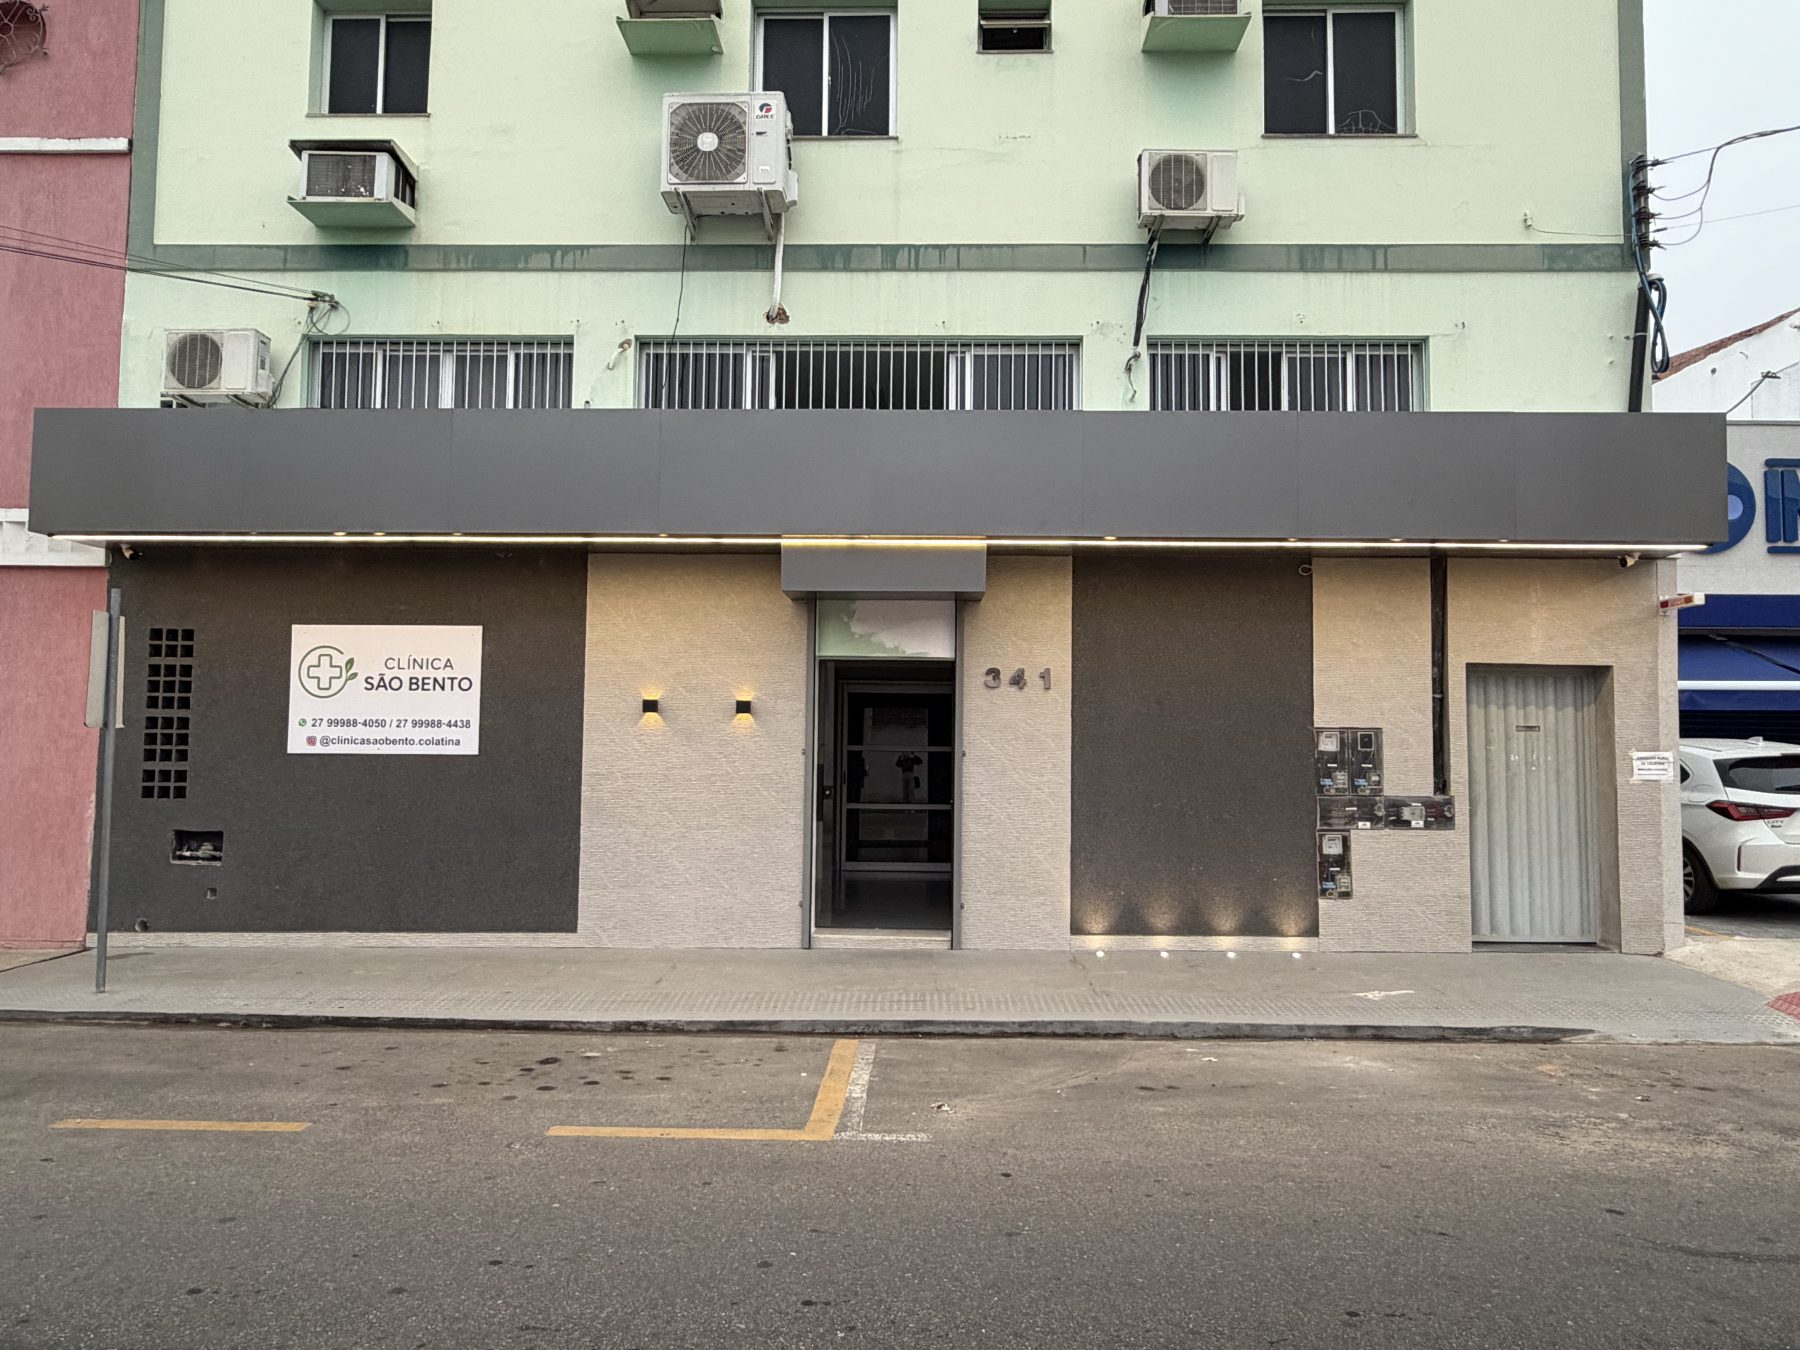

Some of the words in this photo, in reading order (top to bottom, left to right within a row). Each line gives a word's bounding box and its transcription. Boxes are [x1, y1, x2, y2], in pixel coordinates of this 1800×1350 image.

[384, 654, 454, 671] CLÍNICA
[364, 673, 403, 692] SÃO
[408, 676, 473, 692] BENTO
[984, 667, 1051, 690] 341
[311, 718, 324, 728] 27
[327, 718, 387, 728] 99988-4050
[395, 719, 408, 728] 27
[411, 719, 471, 729] 99988-4438
[319, 735, 461, 747] @clinicasaobento.colatina
